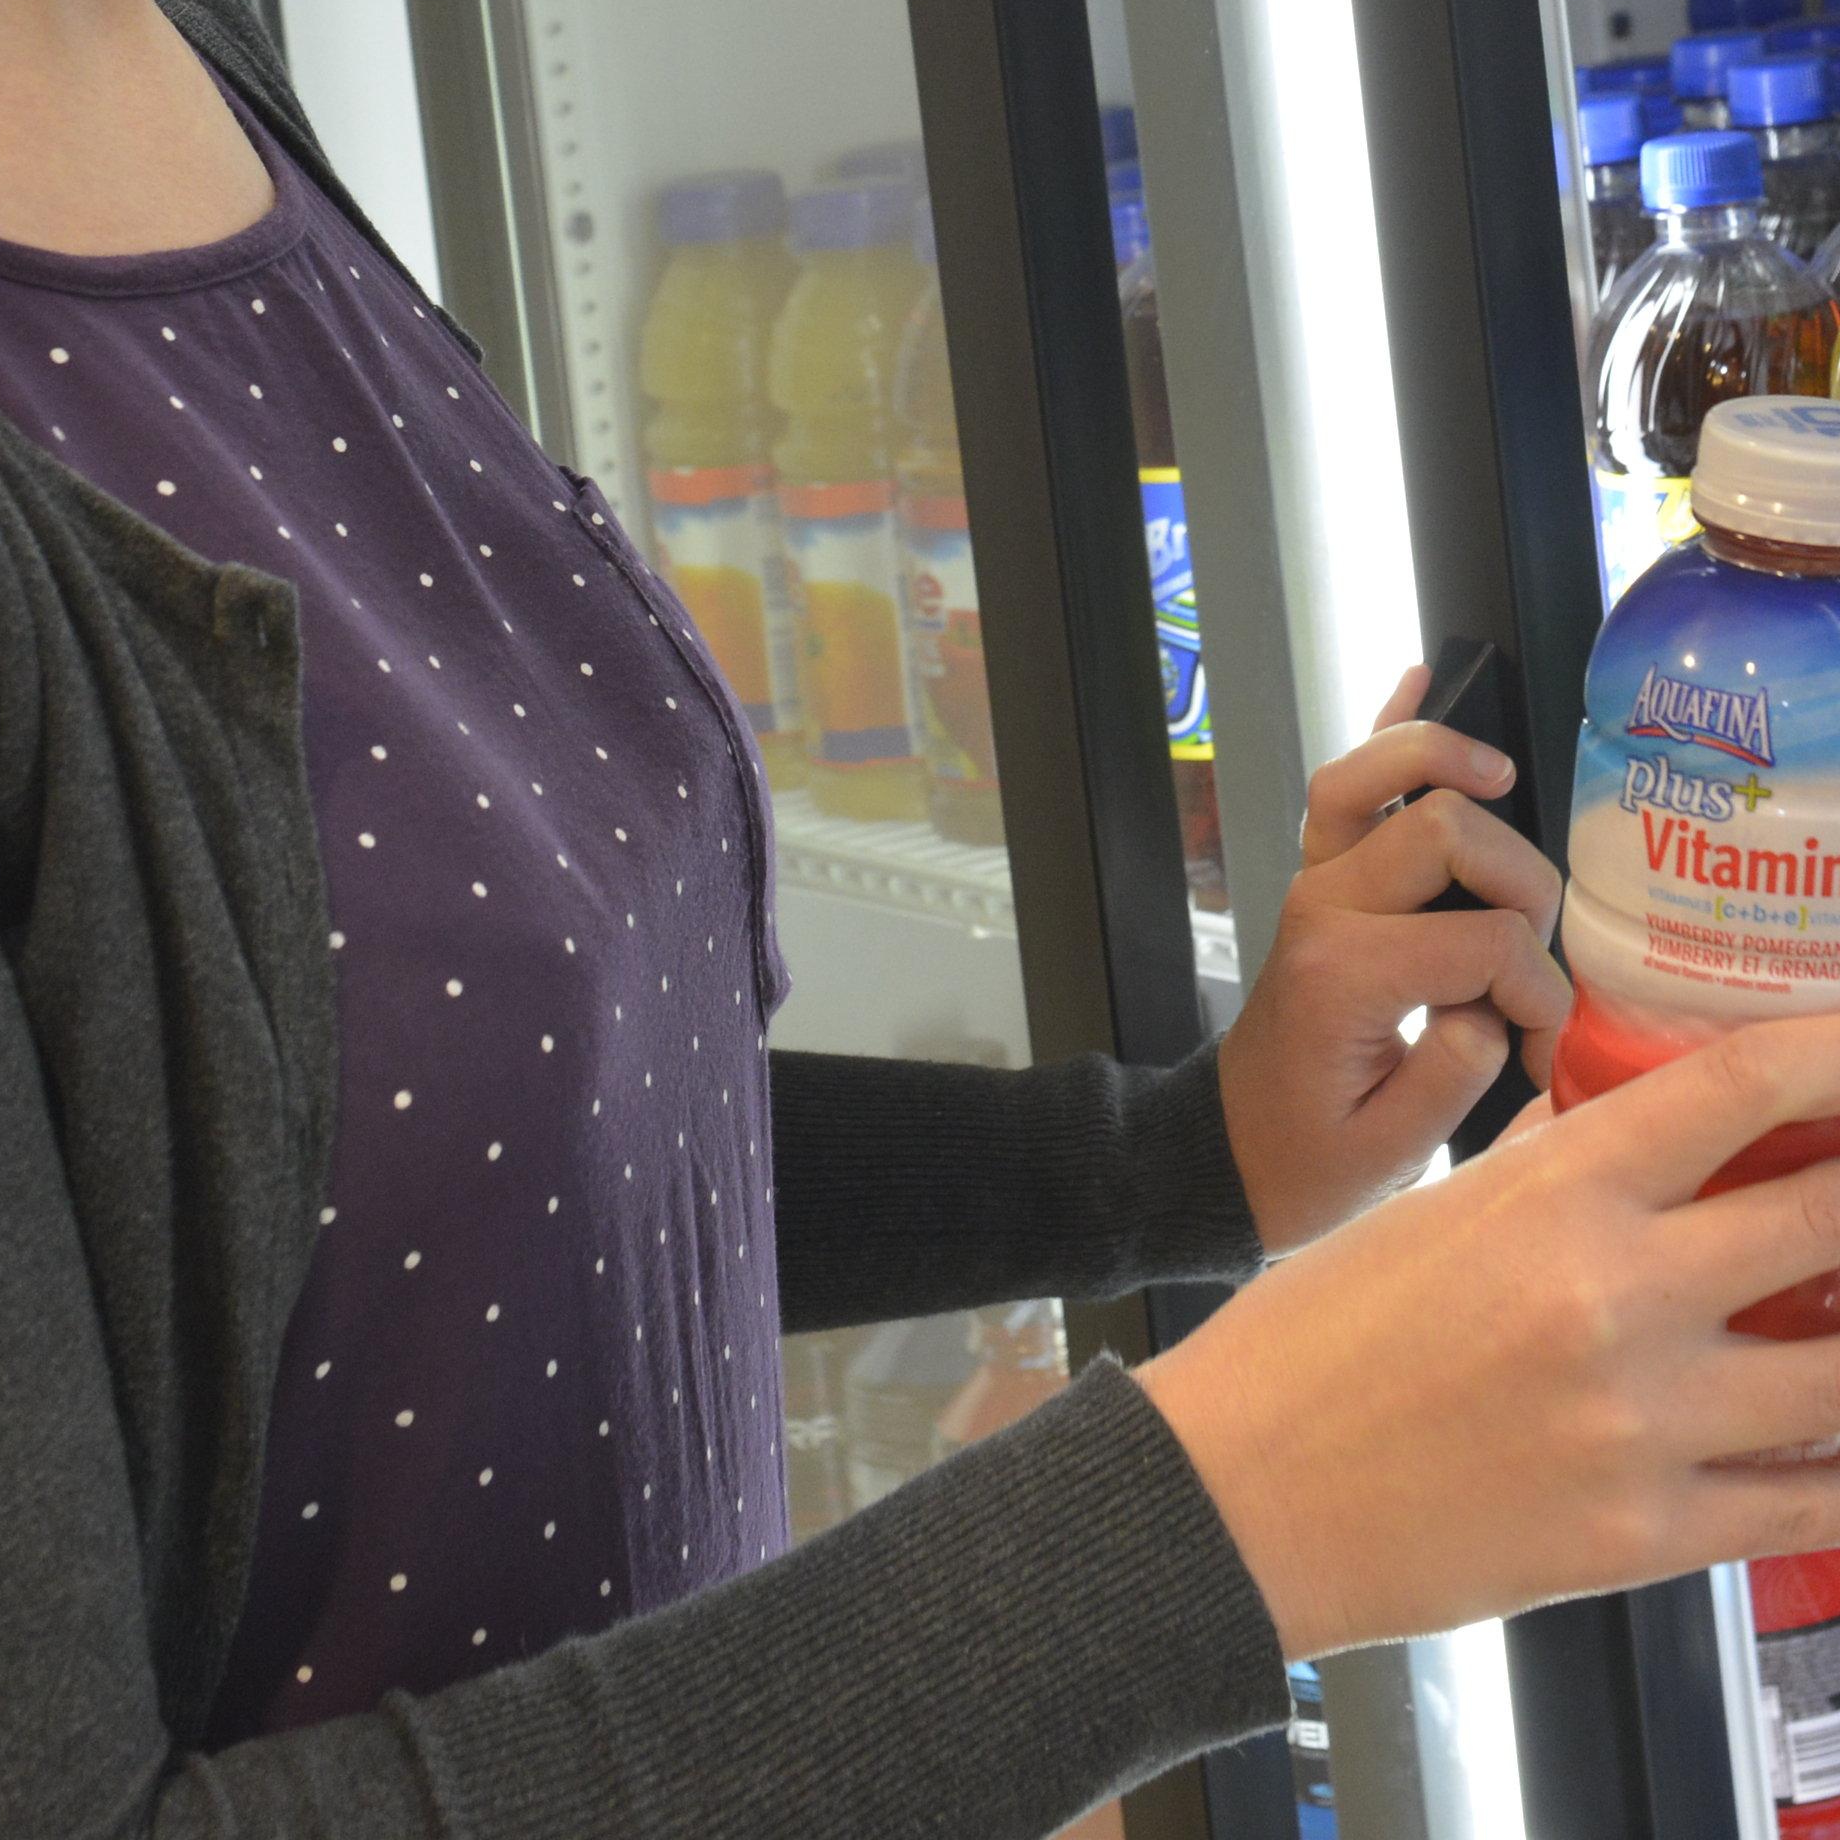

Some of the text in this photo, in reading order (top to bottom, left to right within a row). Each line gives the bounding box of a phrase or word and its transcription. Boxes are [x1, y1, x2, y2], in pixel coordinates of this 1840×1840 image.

[1626, 662, 1774, 765] AQUAFINA
[1646, 912, 1737, 950] YUMBERRY
[1648, 933, 1737, 972] YUMBERRY
[1743, 955, 1760, 976] ET
